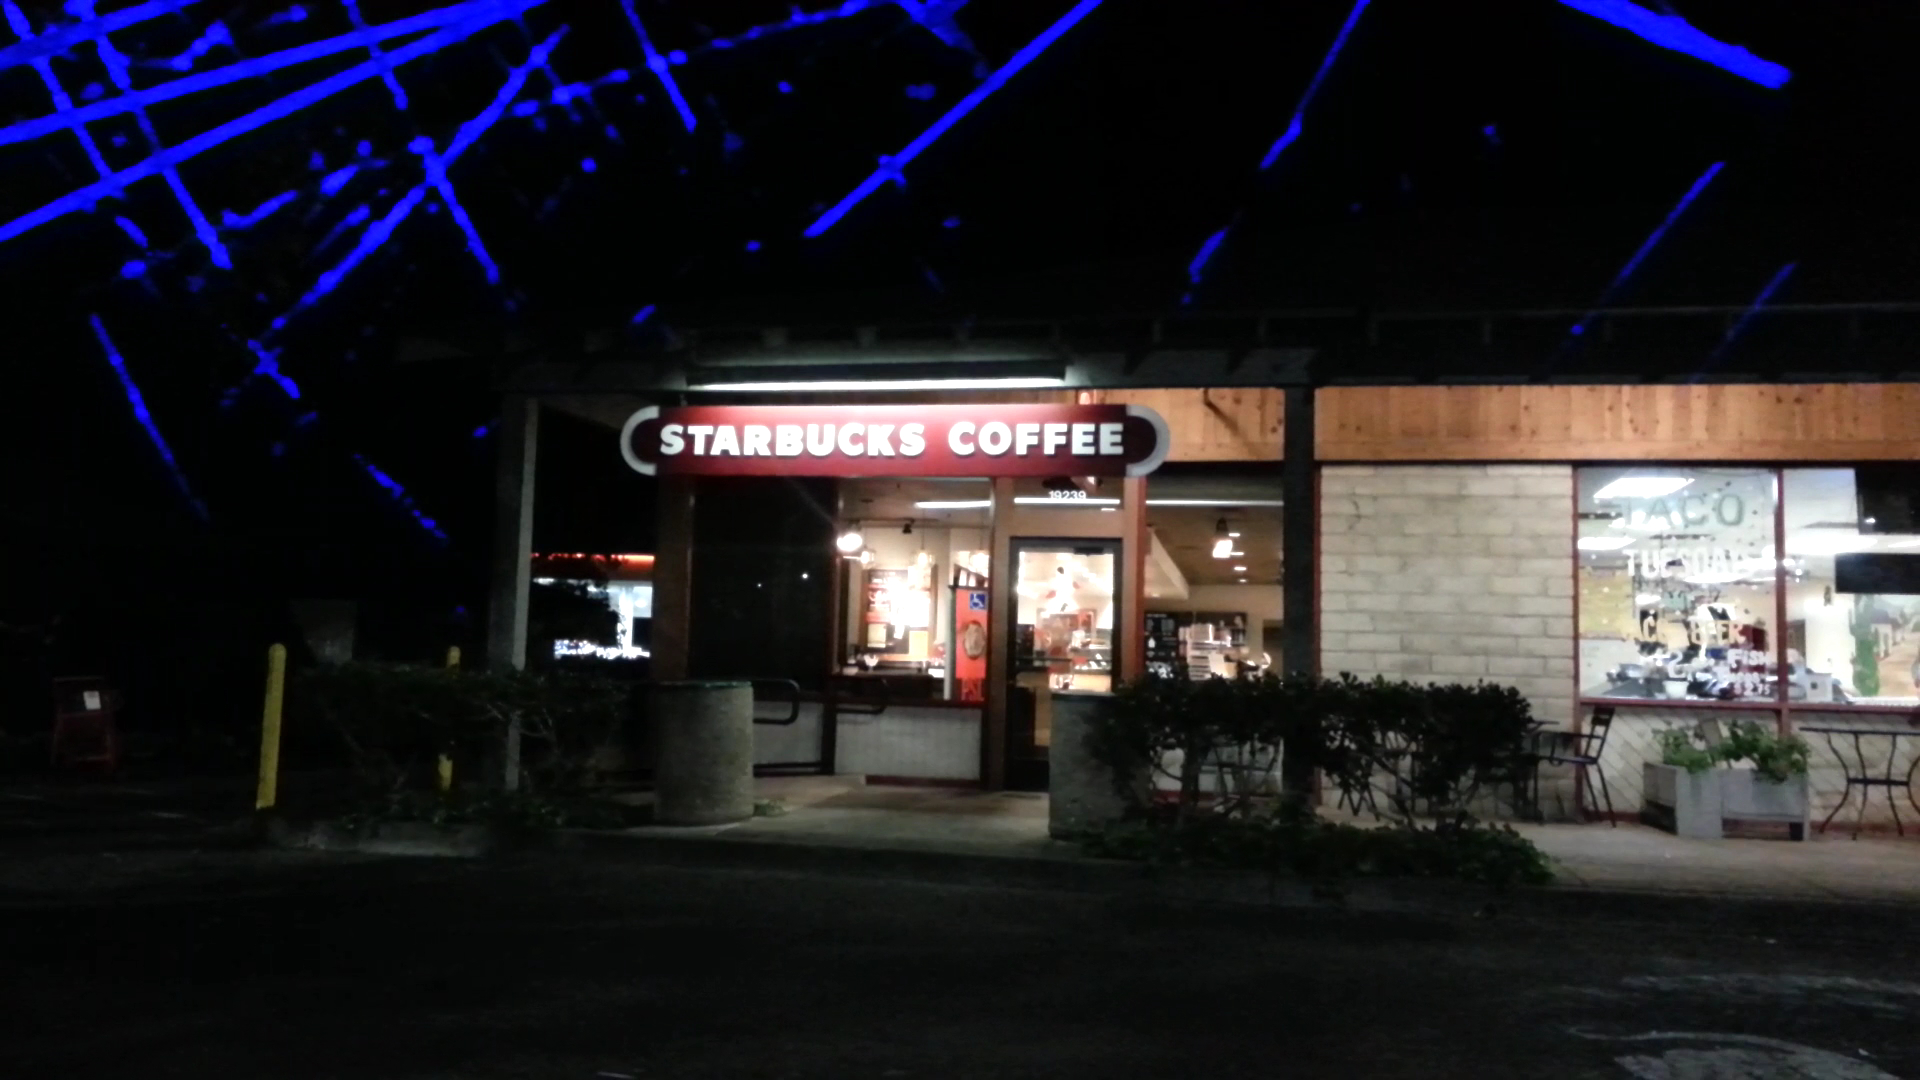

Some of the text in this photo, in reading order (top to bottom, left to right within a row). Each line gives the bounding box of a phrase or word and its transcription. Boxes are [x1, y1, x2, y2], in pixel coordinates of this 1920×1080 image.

[660, 421, 1124, 457] STARBUCKS COFFEE
[1048, 490, 1087, 502] 19239
